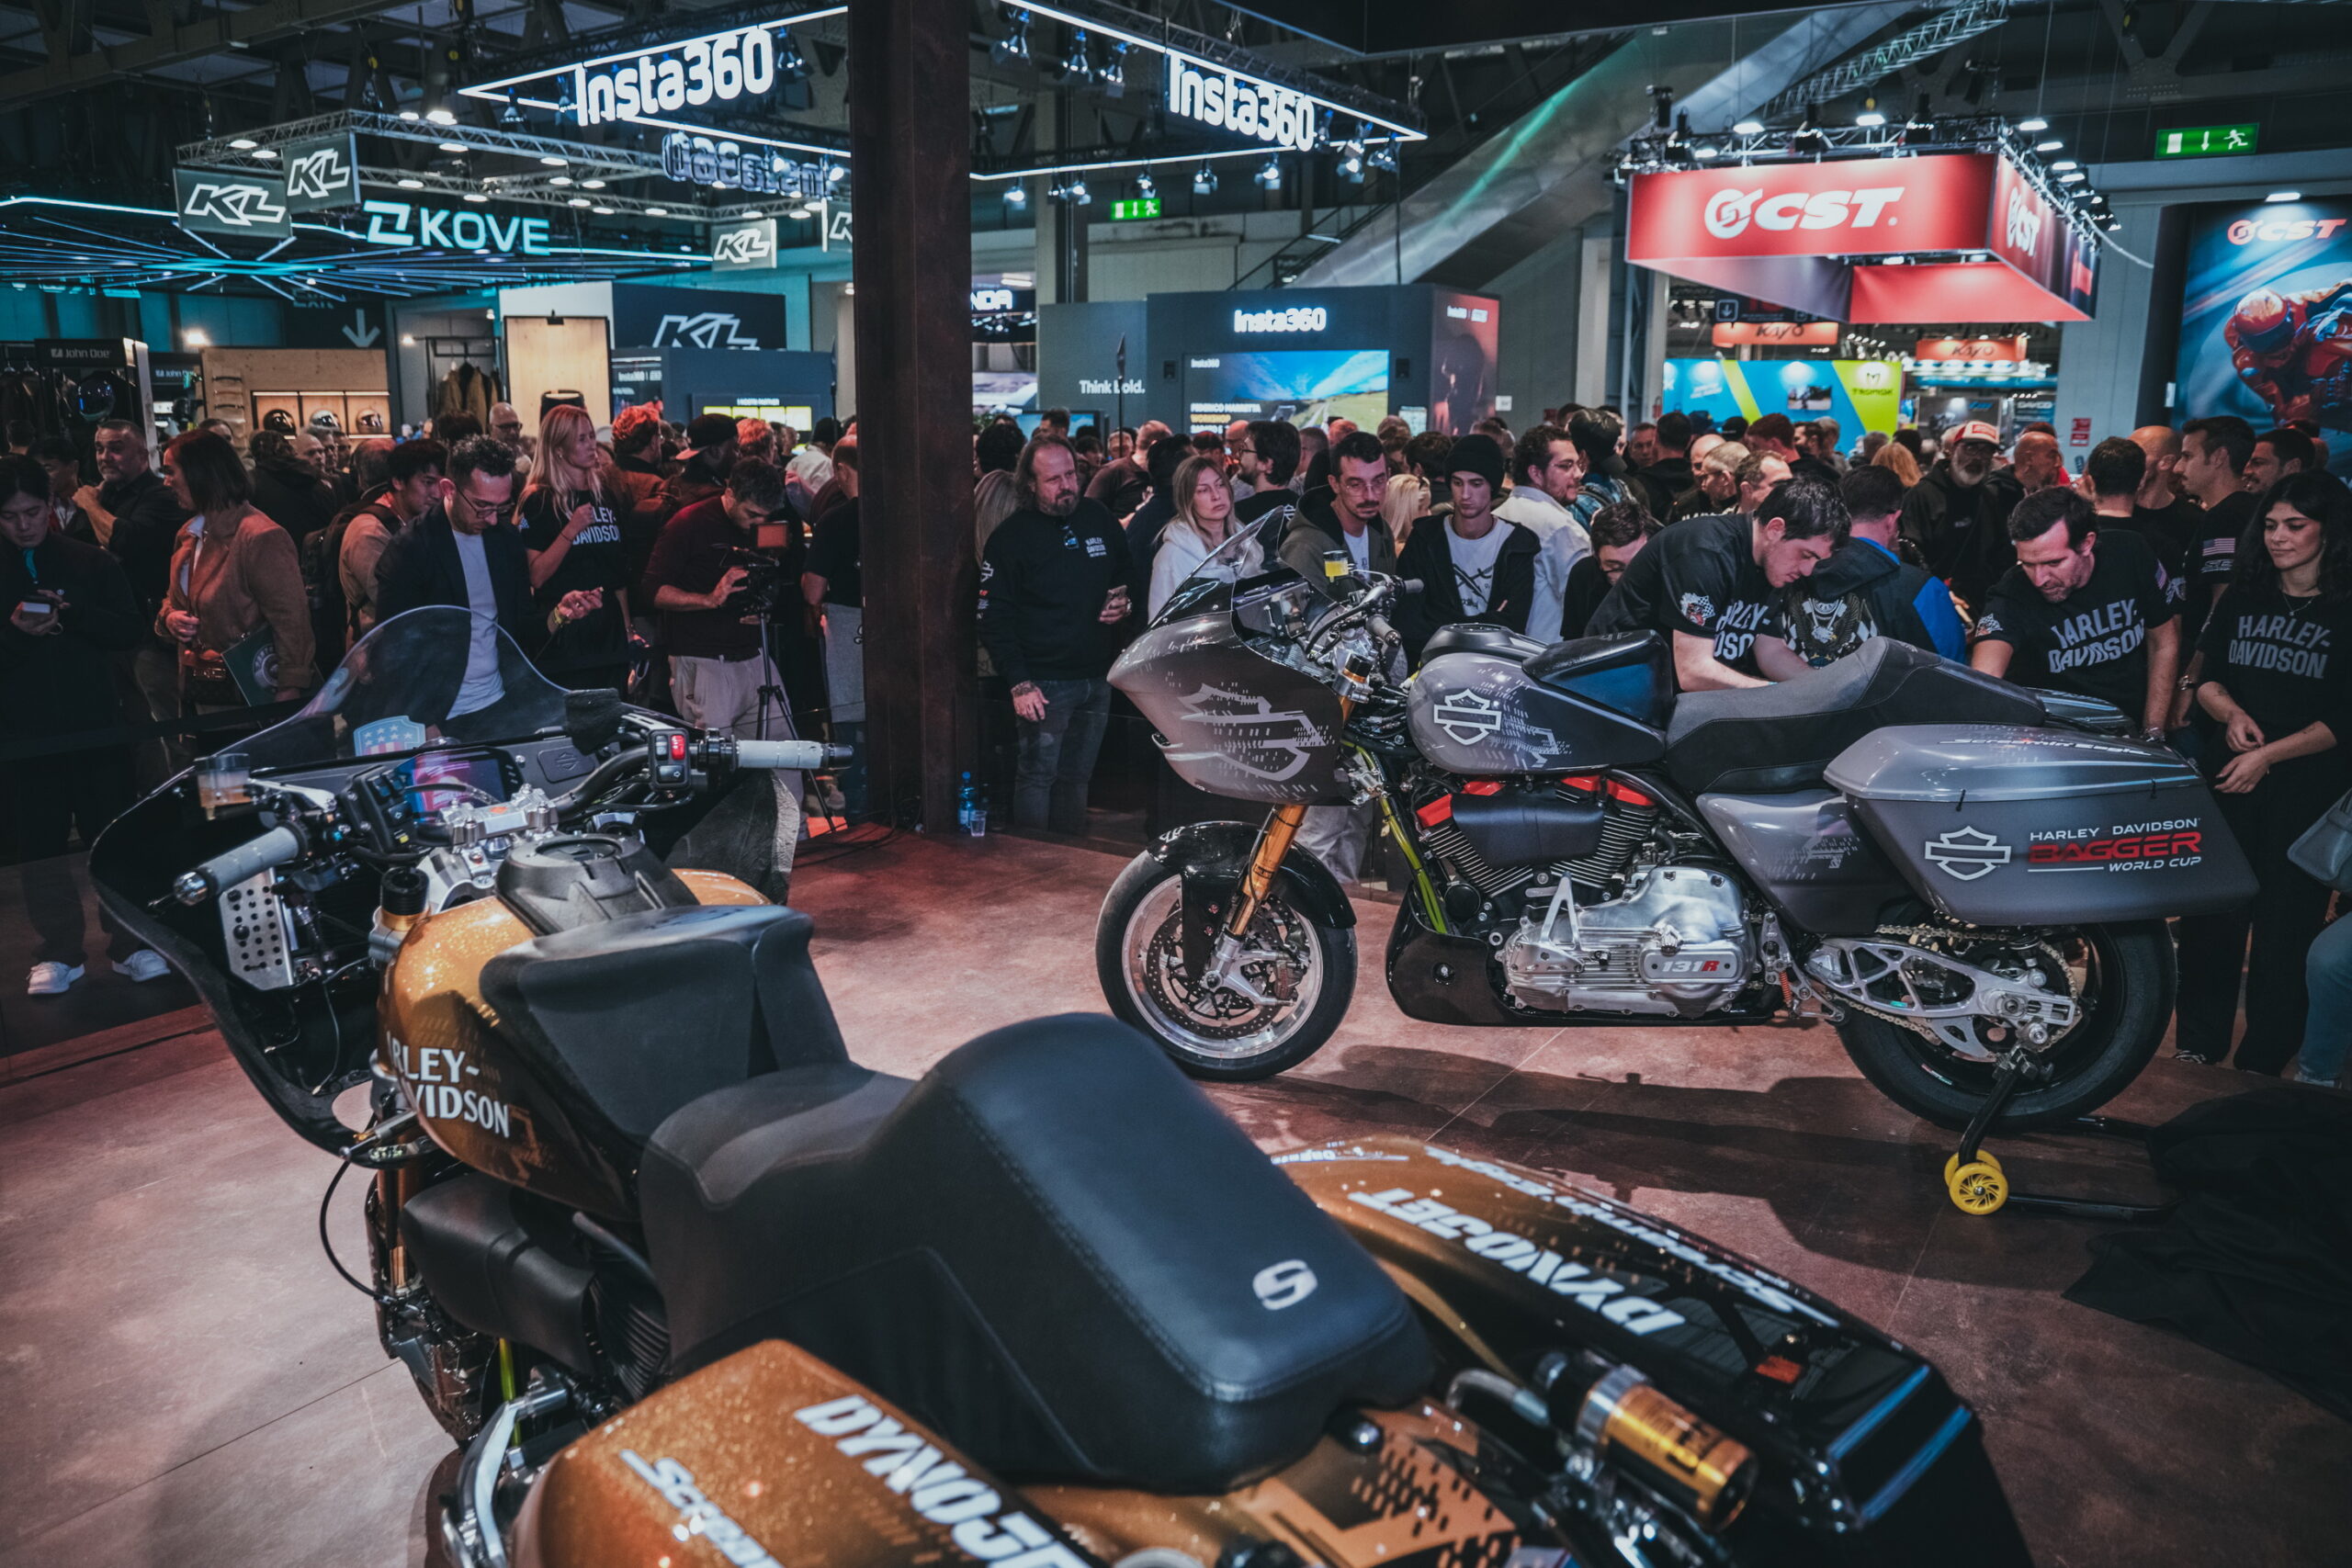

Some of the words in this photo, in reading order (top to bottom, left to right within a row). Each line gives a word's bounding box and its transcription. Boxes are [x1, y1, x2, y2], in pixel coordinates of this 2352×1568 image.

[574, 26, 774, 127] Insta360
[1170, 53, 1315, 152] Insta360
[420, 207, 551, 256] KOVE
[1234, 307, 1327, 333] Insta360
[65, 348, 88, 360] John
[1079, 379, 1113, 394] Think
[572, 524, 621, 546] DAVIDSO
[2237, 615, 2331, 649] HARLEY-
[2228, 639, 2329, 680] DAVIDSON
[2030, 828, 2100, 841] HARLEY
[2112, 818, 2202, 836] DAVIDSON
[2028, 830, 2203, 864] BAGGER
[2109, 859, 2165, 873] WORLD
[2169, 855, 2202, 867] CUP
[1662, 960, 1720, 973] 131R
[1347, 1187, 1687, 1337] DYNOJET
